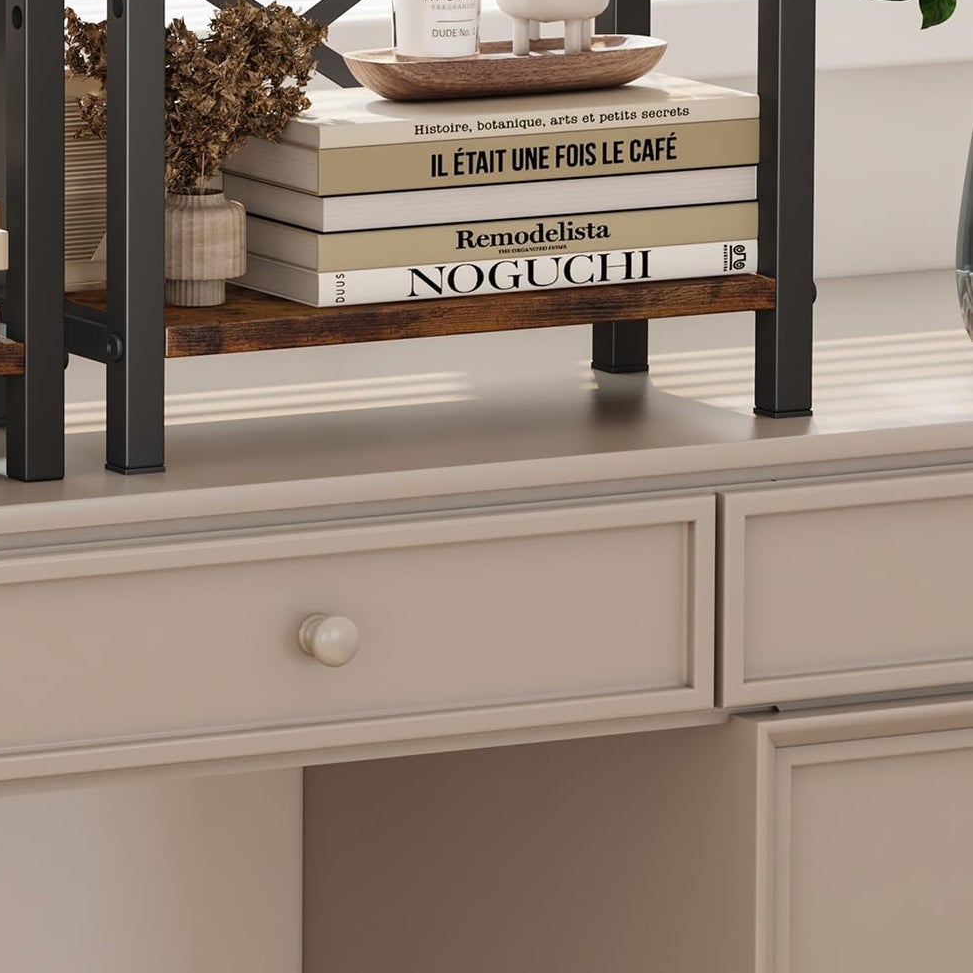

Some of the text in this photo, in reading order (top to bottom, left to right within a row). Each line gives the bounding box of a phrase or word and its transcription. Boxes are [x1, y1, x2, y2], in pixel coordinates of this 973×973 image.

[432, 28, 457, 38] DUDE
[414, 106, 690, 135] Histoire, botanique, arts et petits secrets
[431, 132, 677, 177] IL ÉTAIT UNE FOIS LE CAFÉ
[455, 221, 611, 250] Remodelista
[407, 249, 652, 297] NOGUCHI
[335, 273, 346, 304] DUUS
